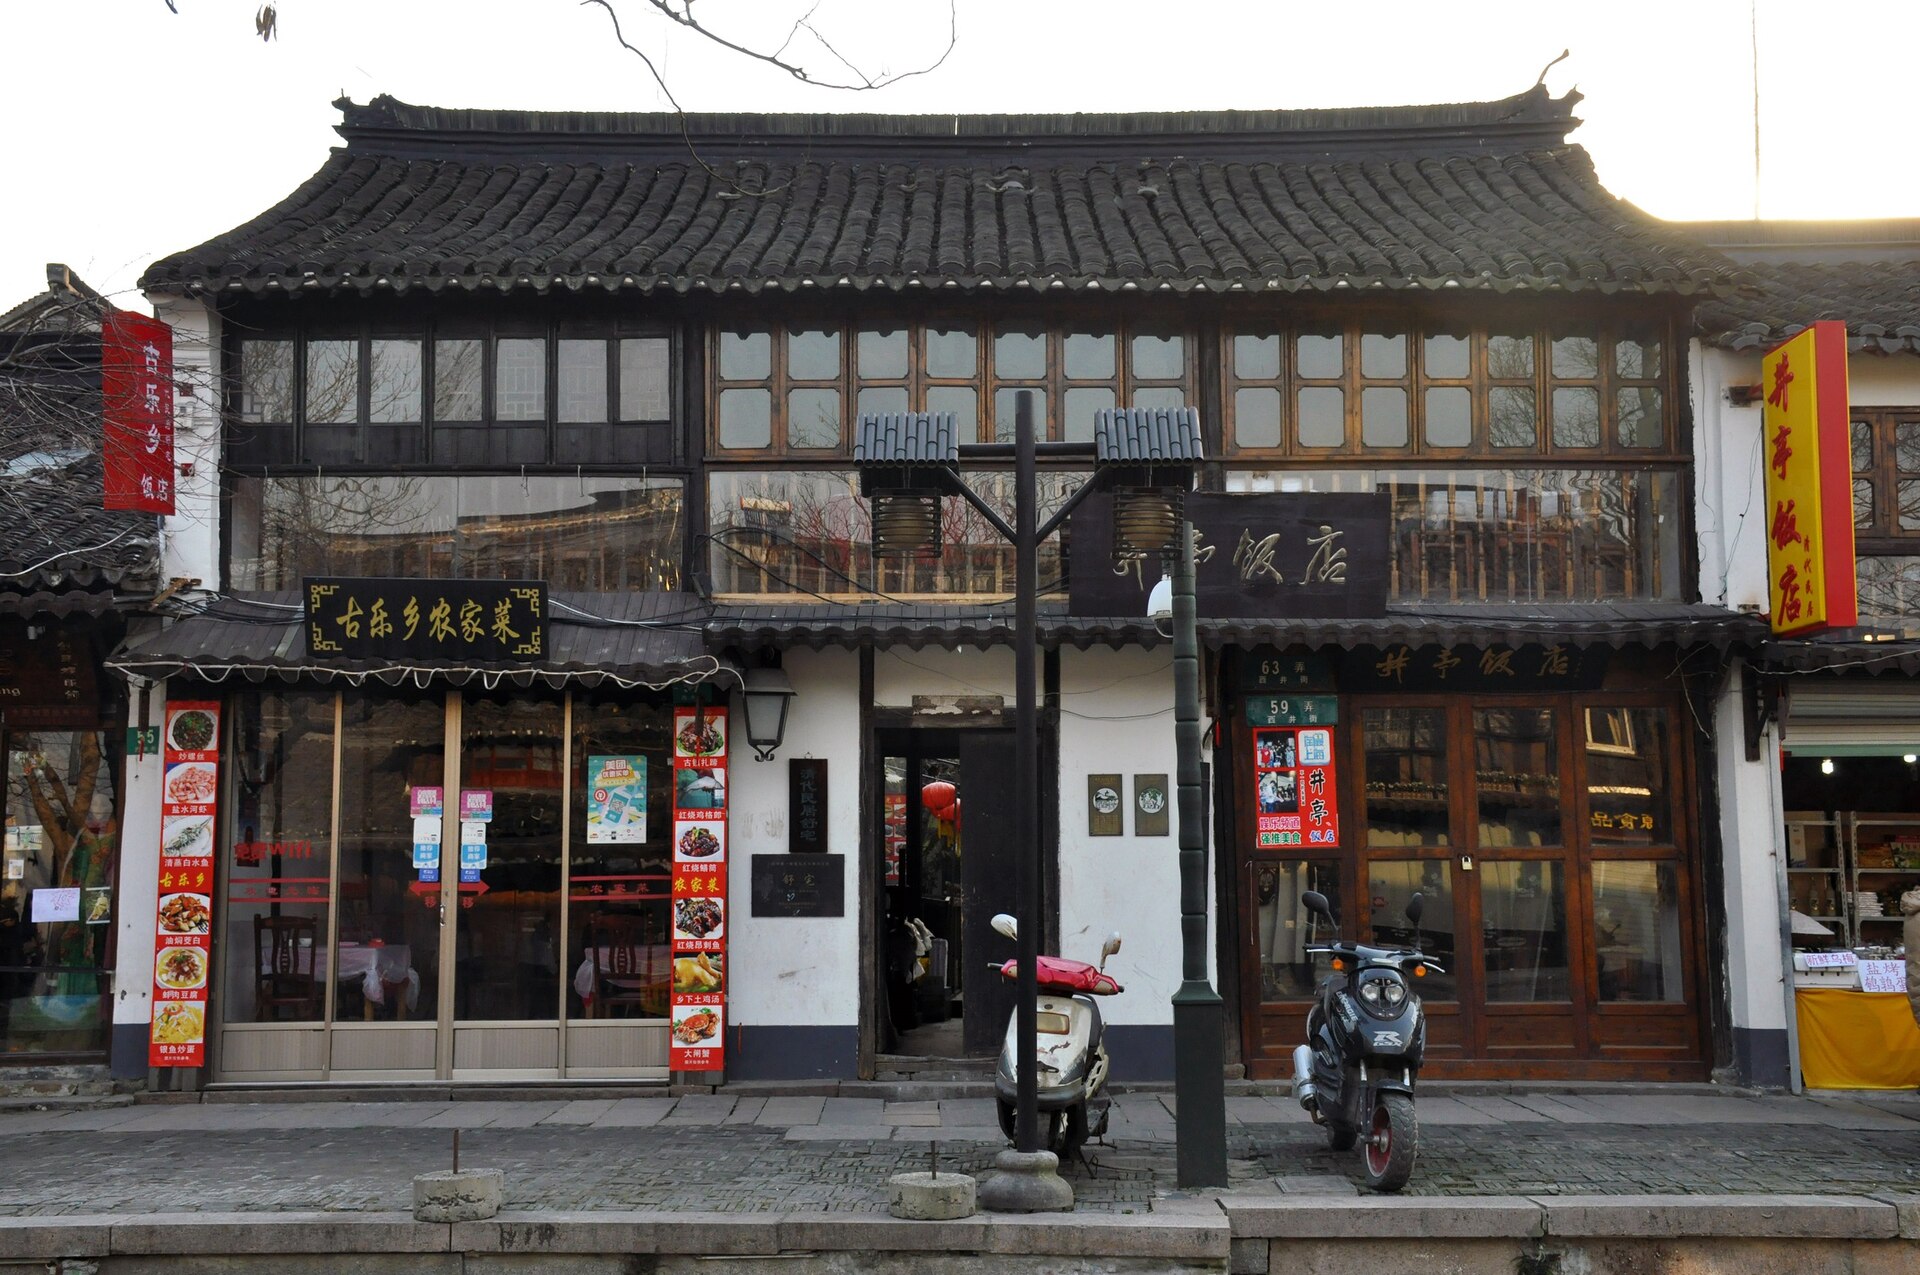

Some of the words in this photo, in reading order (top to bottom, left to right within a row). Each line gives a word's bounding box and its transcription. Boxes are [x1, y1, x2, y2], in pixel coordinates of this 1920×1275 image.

[1767, 351, 1802, 627] 井亭饭店
[336, 596, 521, 645] 古乐乡农家菜
[1261, 660, 1280, 675] 63
[1294, 661, 1305, 673] 弄
[1375, 645, 1570, 684] 井亭饭店
[1270, 700, 1289, 714] 59
[1303, 701, 1314, 712] 弄
[1267, 714, 1318, 724] 西井街
[178, 752, 205, 761] 炒螺丝
[1309, 768, 1328, 826] 井亭
[171, 805, 207, 814] 盐水河虾
[1259, 817, 1301, 830] 娱乐频道
[1261, 832, 1302, 845] 强推美食
[1310, 831, 1335, 843] 饭店
[164, 858, 210, 868] 清蒸白水鱼
[160, 871, 206, 888] 古乐乡
[674, 877, 720, 893] 农家菜
[164, 936, 201, 946] 油焖茭白
[677, 941, 721, 950] 红烧昂刺鱼
[1806, 953, 1854, 966] 新鲜乌梅
[1866, 962, 1901, 976] 盐烤
[676, 995, 721, 1004] 乡下土鸡汤
[159, 1045, 196, 1054] 银鱼炒蛋
[684, 1048, 710, 1058] 大闸蟹
